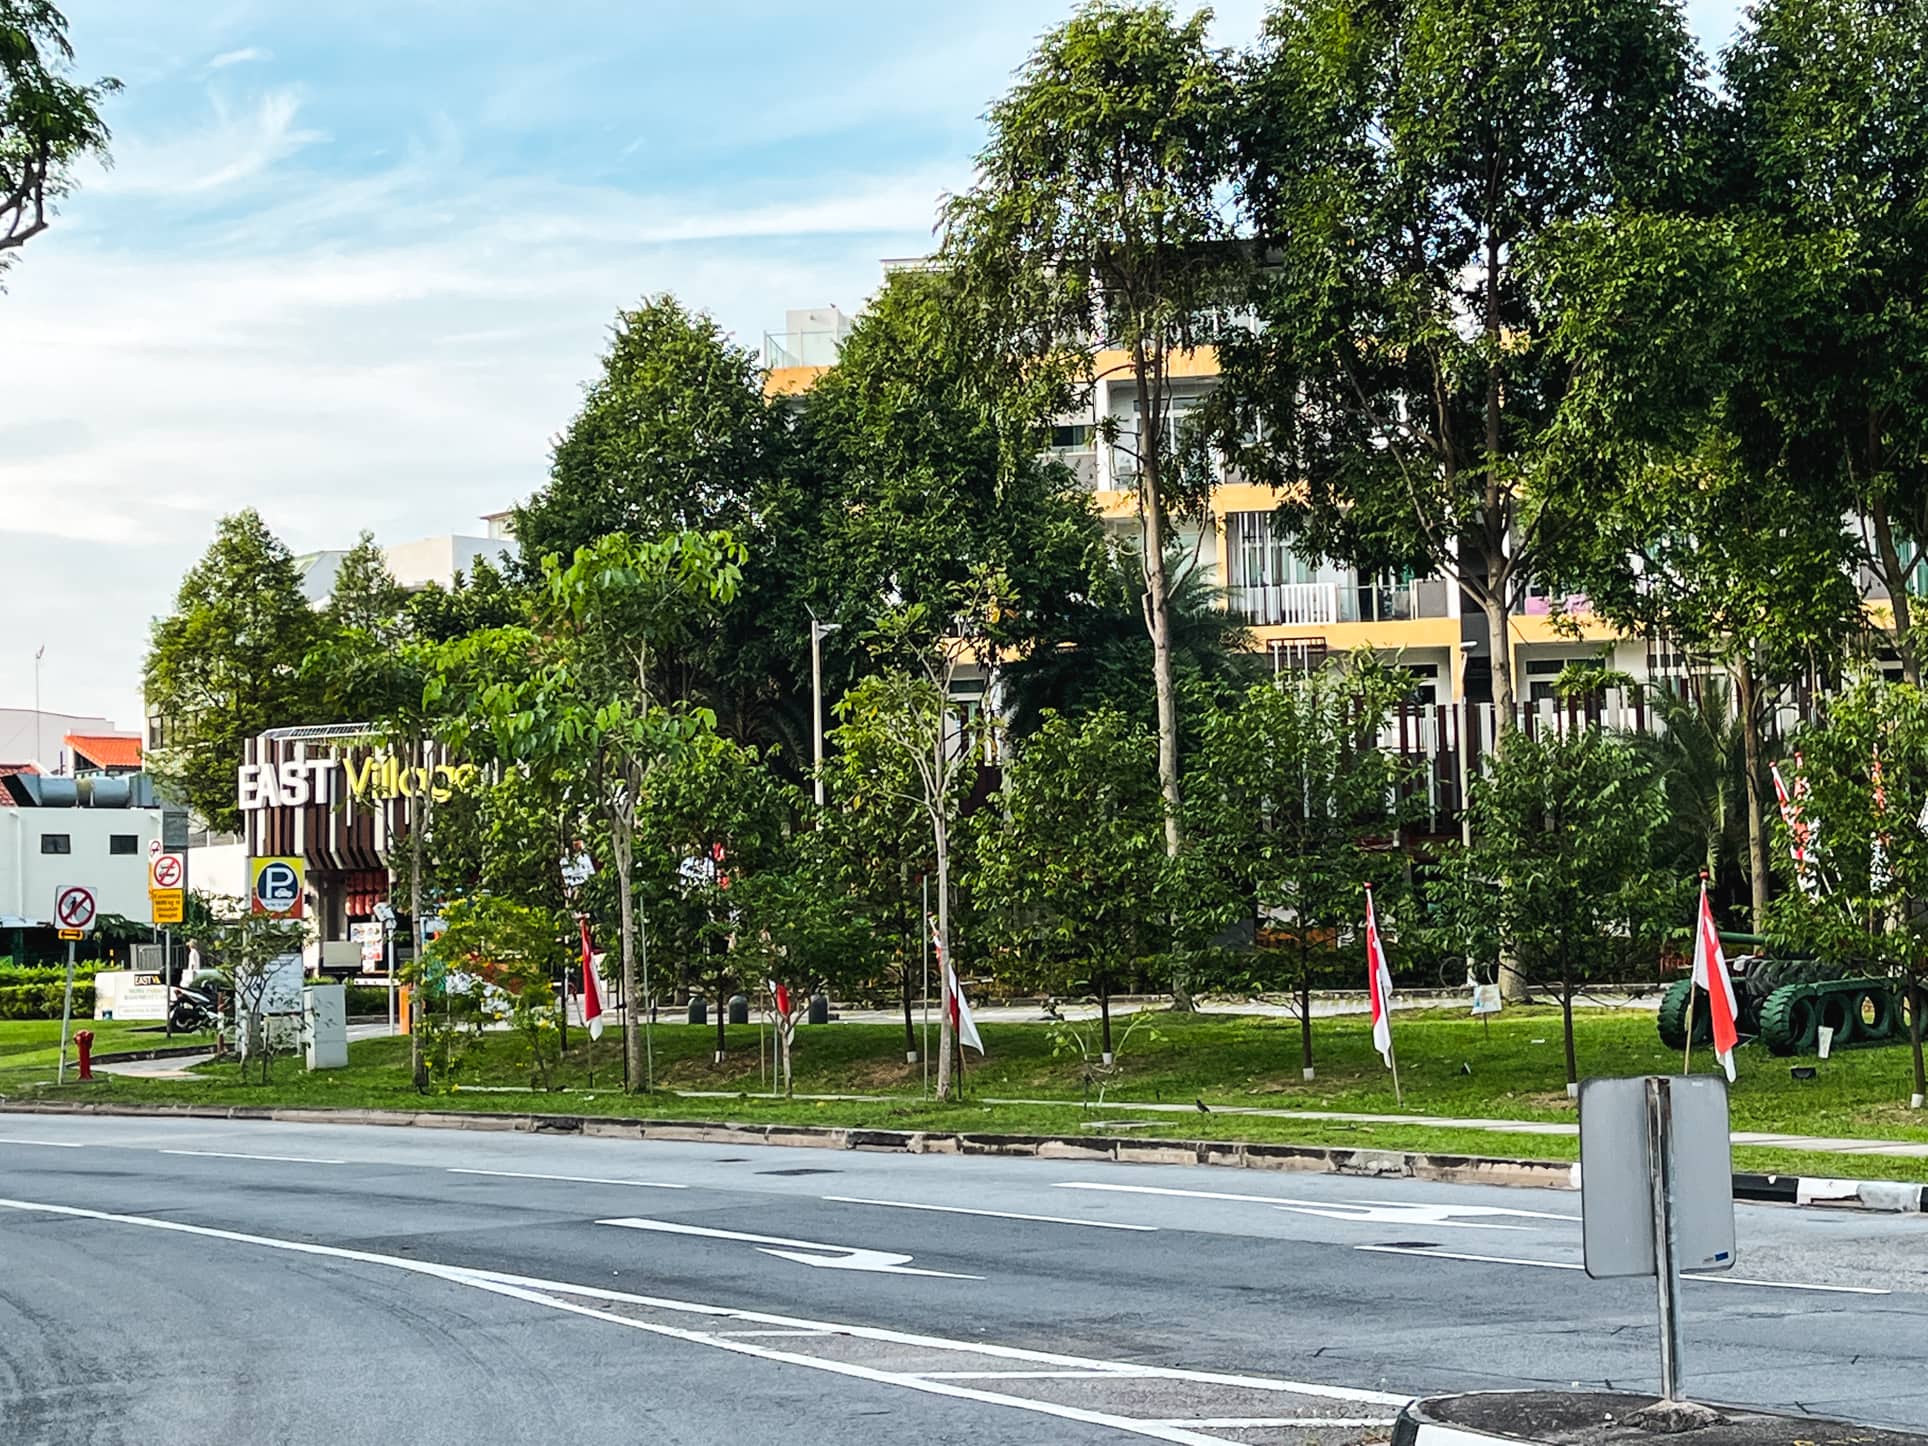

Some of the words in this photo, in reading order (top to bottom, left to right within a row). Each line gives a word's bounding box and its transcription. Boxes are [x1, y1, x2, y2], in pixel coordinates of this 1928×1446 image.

[238, 759, 336, 811] EAST
[343, 755, 480, 803] Village
[266, 867, 294, 899] P
[134, 975, 152, 985] EAST
